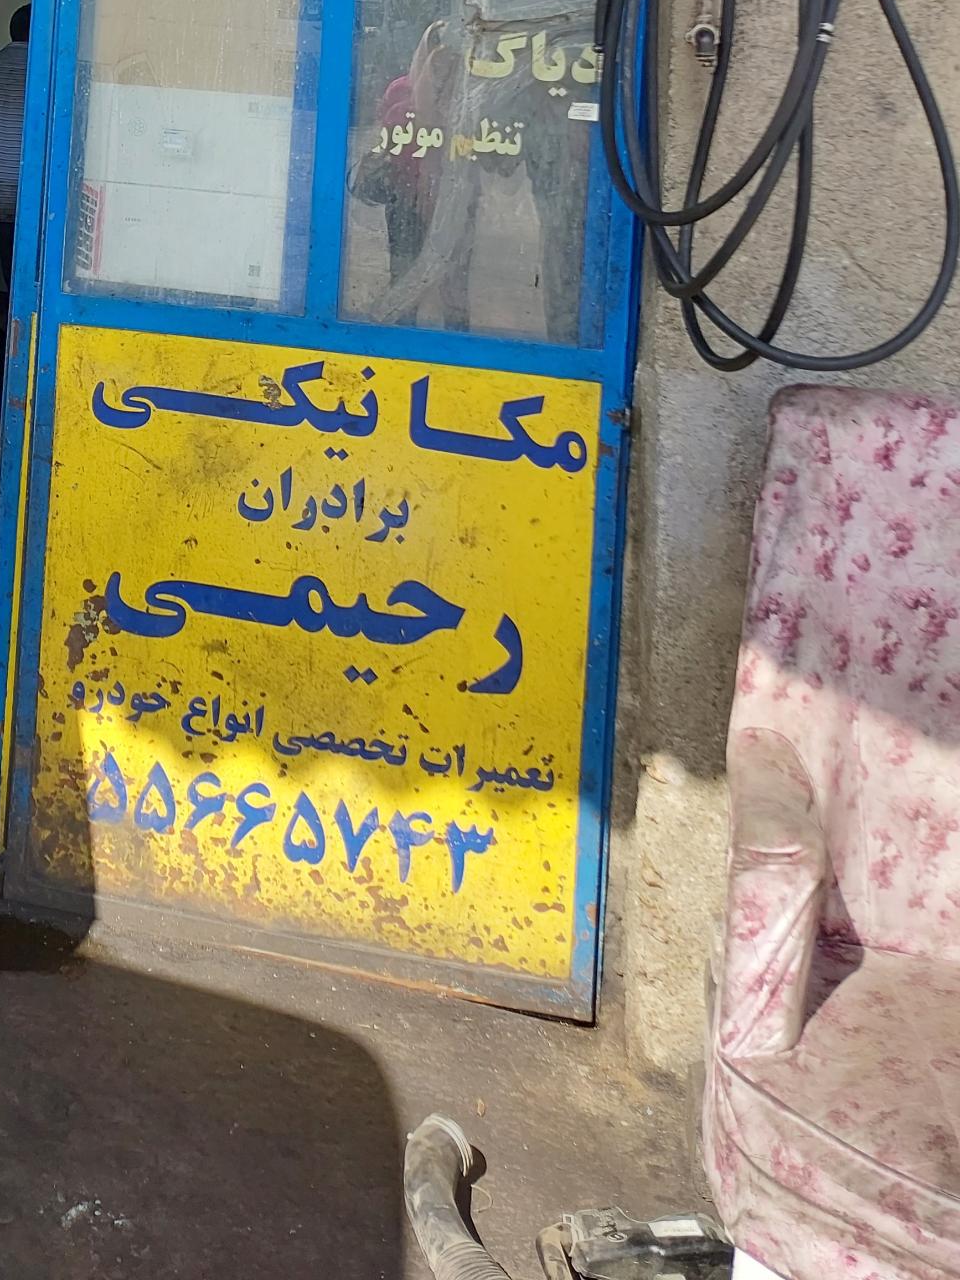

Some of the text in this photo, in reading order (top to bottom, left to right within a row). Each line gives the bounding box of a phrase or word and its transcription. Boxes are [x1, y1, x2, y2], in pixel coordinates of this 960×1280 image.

[371, 112, 525, 161] تنظیم موتور
[237, 465, 410, 545] برادران
[104, 570, 523, 694] رحیمی
[71, 679, 556, 793] تعمیرات تخصصی انواع خودرو
[88, 751, 495, 894] ۵۵۶۶۵۷۴۳
